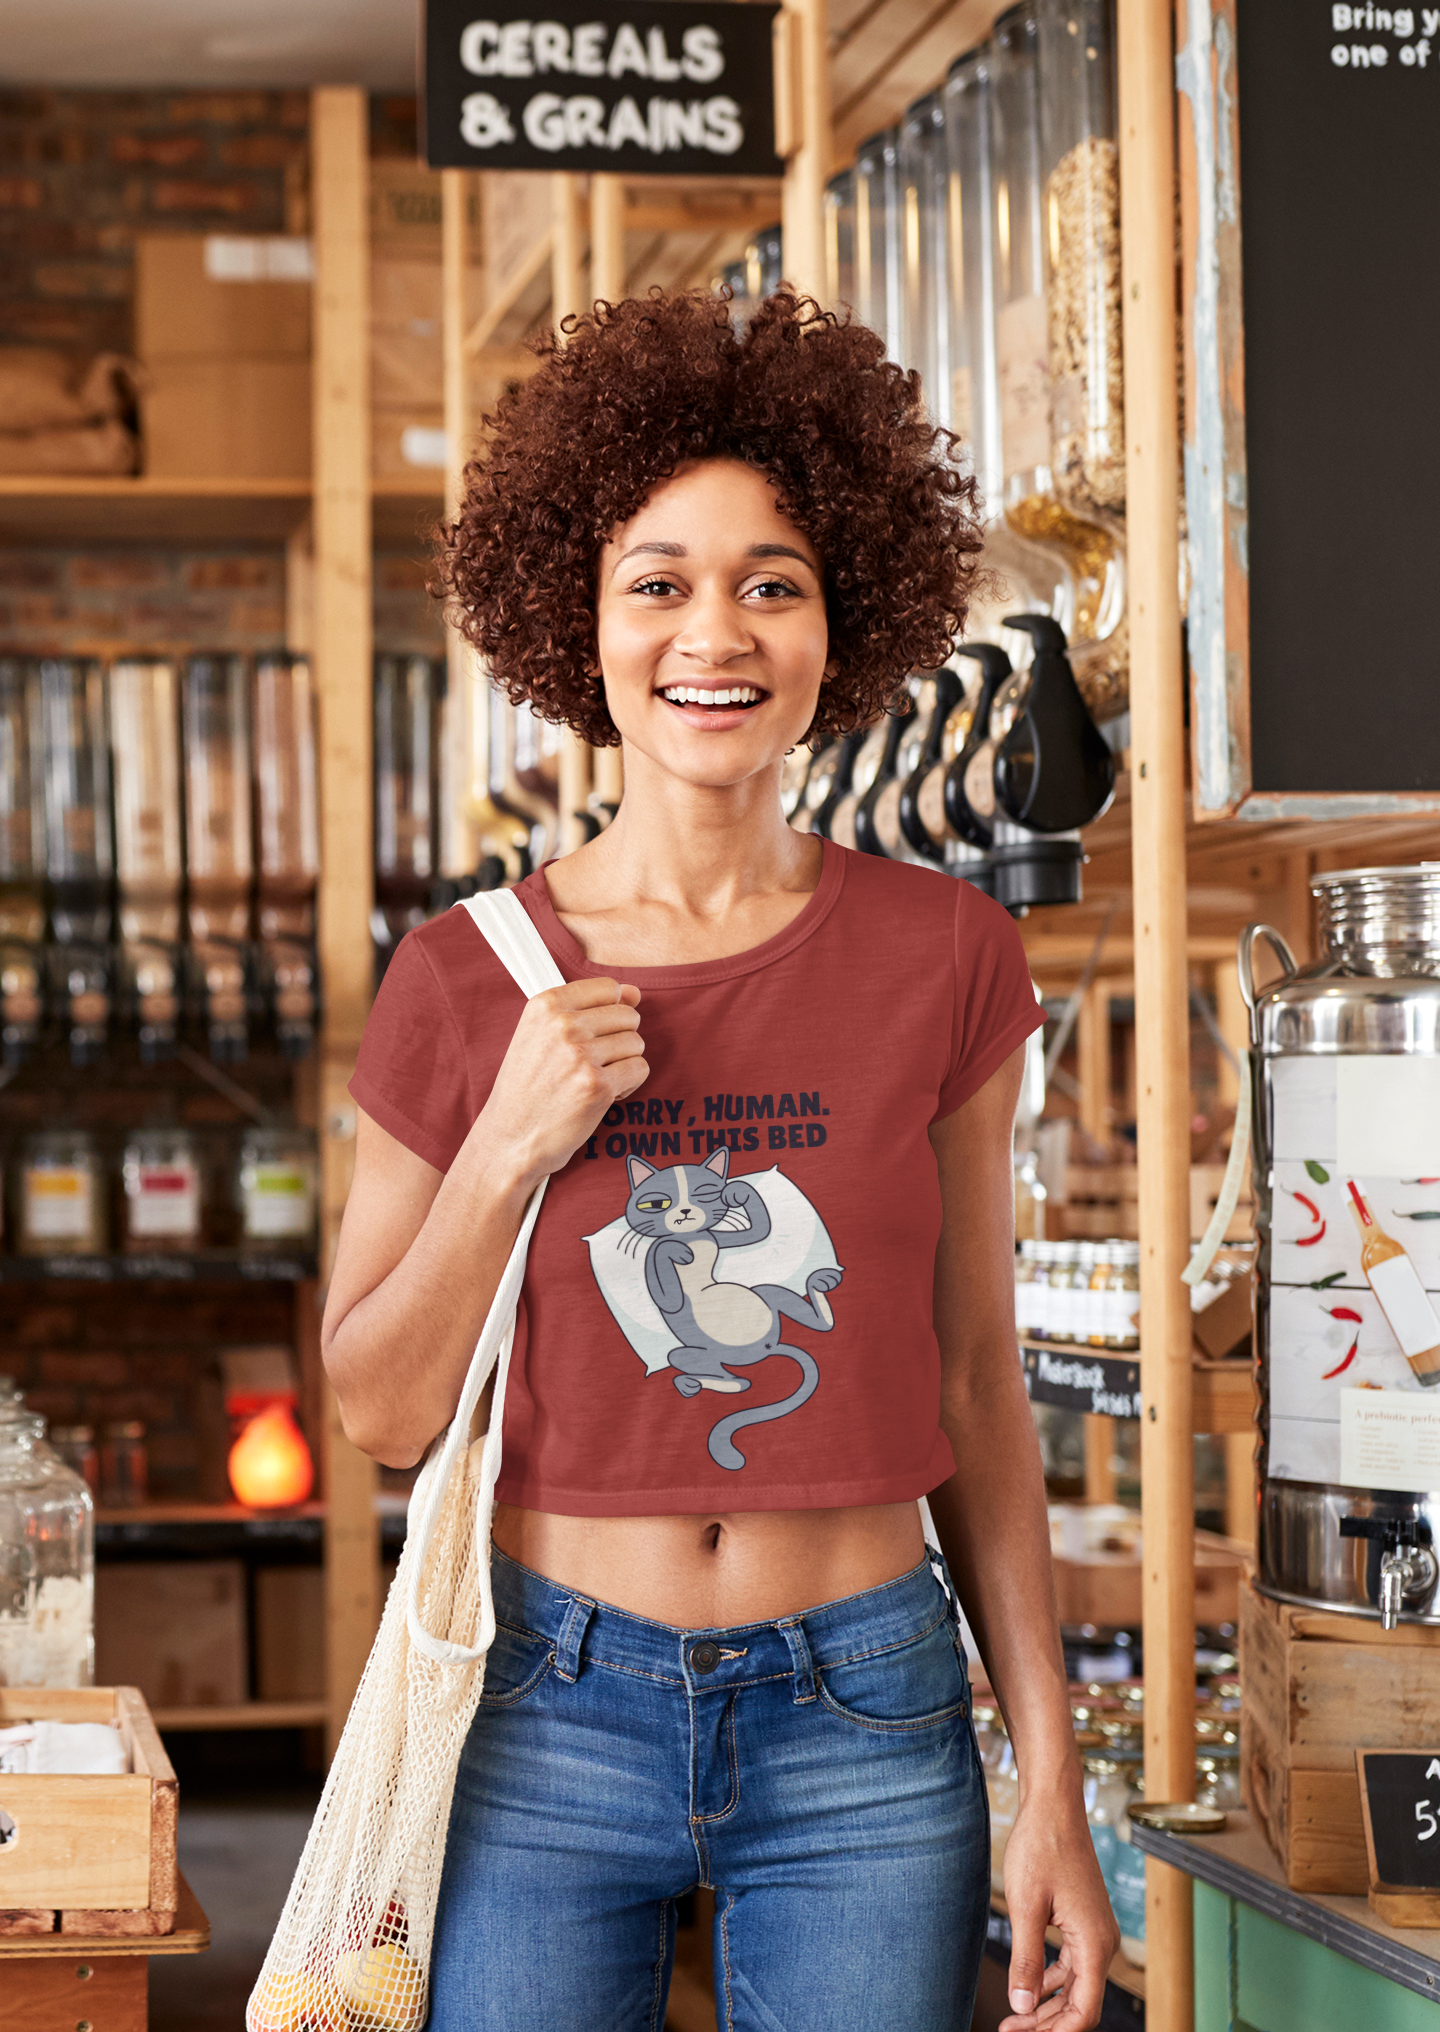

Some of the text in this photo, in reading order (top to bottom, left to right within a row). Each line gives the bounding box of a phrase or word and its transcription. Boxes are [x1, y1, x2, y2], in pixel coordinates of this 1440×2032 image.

[1332, 0, 1440, 38] Bring y
[459, 19, 725, 83] CEREALS
[1331, 38, 1432, 69] one of
[460, 91, 744, 155] & GRAINS
[602, 1091, 830, 1127] ORRY, HUMAN.
[584, 1123, 827, 1160] I OWN THIS BED
[1415, 1800, 1440, 1841] 5
